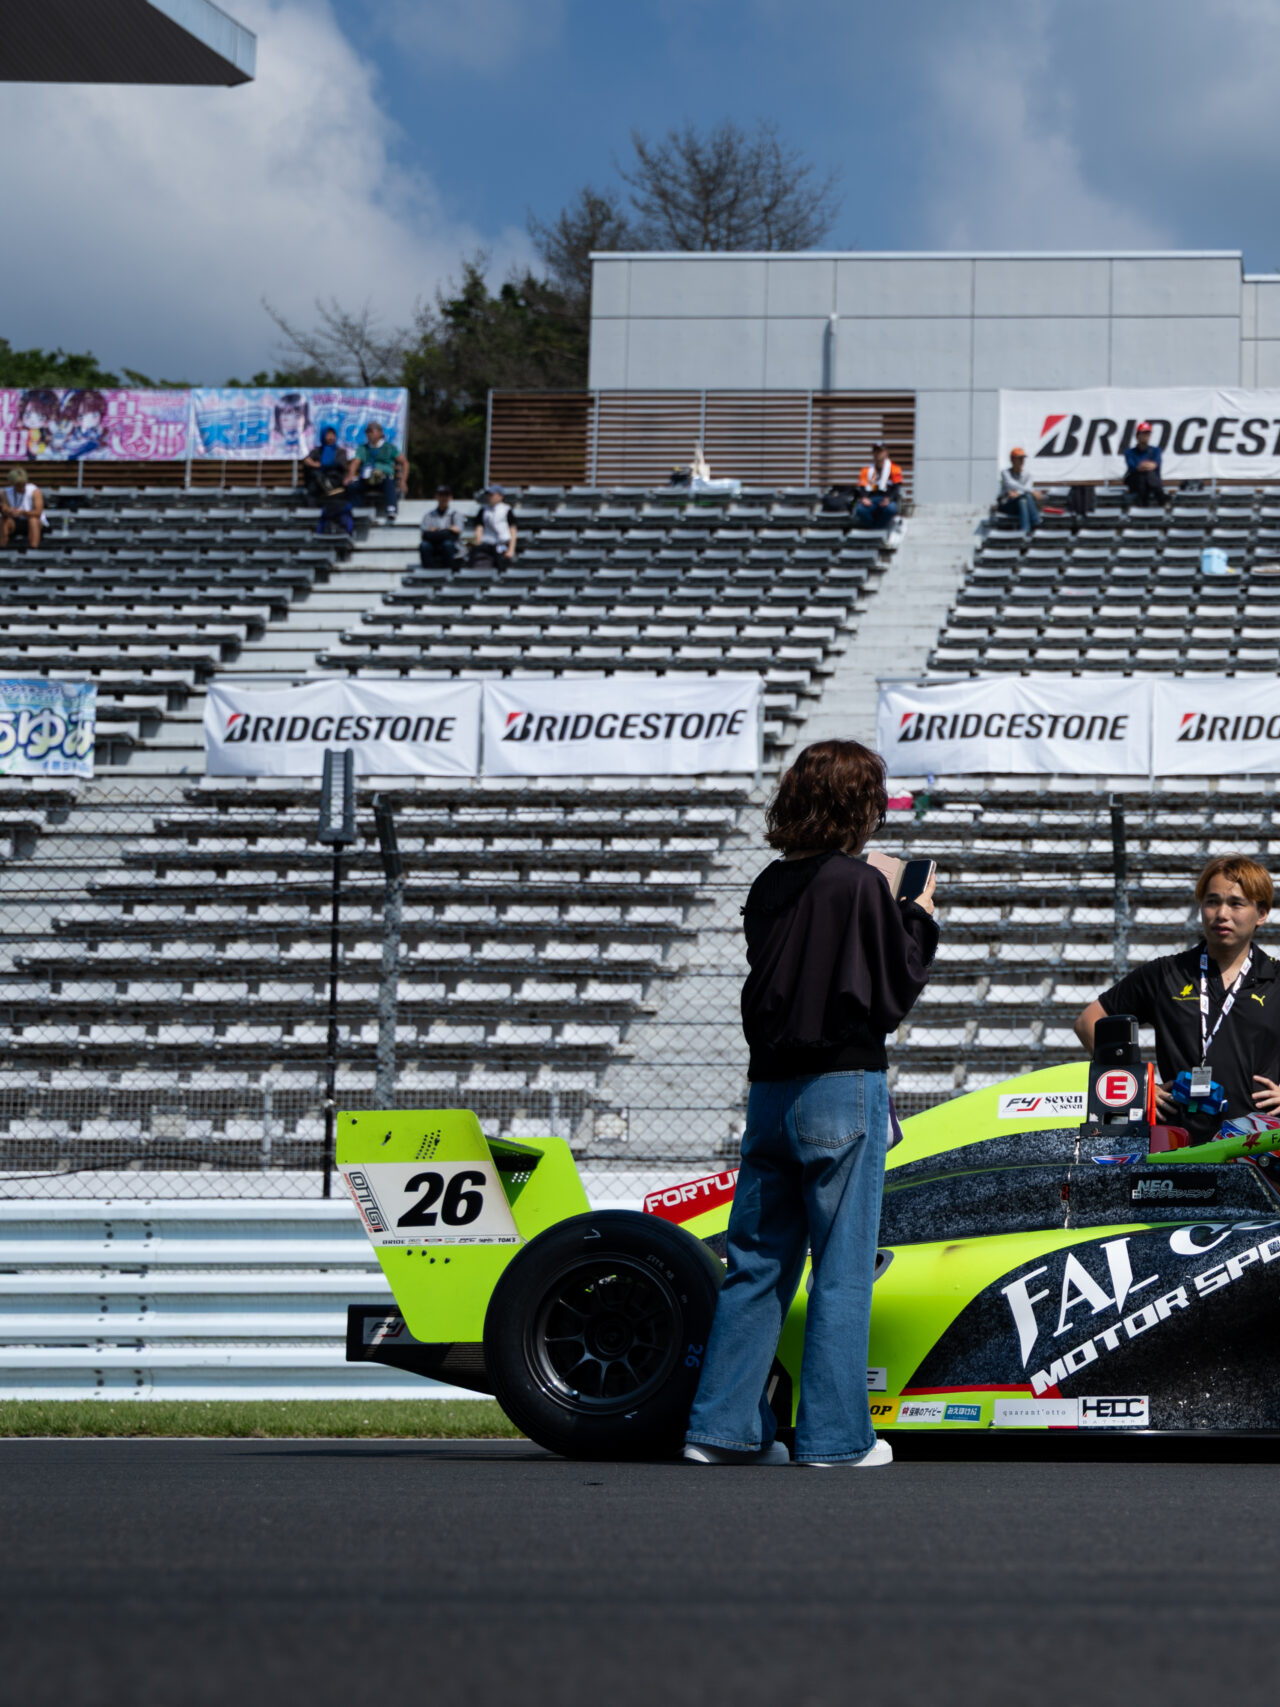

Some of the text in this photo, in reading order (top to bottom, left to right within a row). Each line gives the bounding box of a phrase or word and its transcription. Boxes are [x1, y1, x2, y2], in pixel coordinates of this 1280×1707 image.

[224, 713, 456, 744] BRIDGESTONE
[502, 709, 748, 742] BRIDGESTONE
[898, 712, 1129, 742] BRIDGESTONE
[1045, 1095, 1083, 1104] seven
[1105, 1075, 1128, 1100] E
[397, 1170, 487, 1228] 26
[1137, 1179, 1174, 1192] NEO
[1030, 1286, 1190, 1396] MOTOR
[684, 1343, 704, 1369] 26
[1002, 1408, 1066, 1417] quarant'otto
